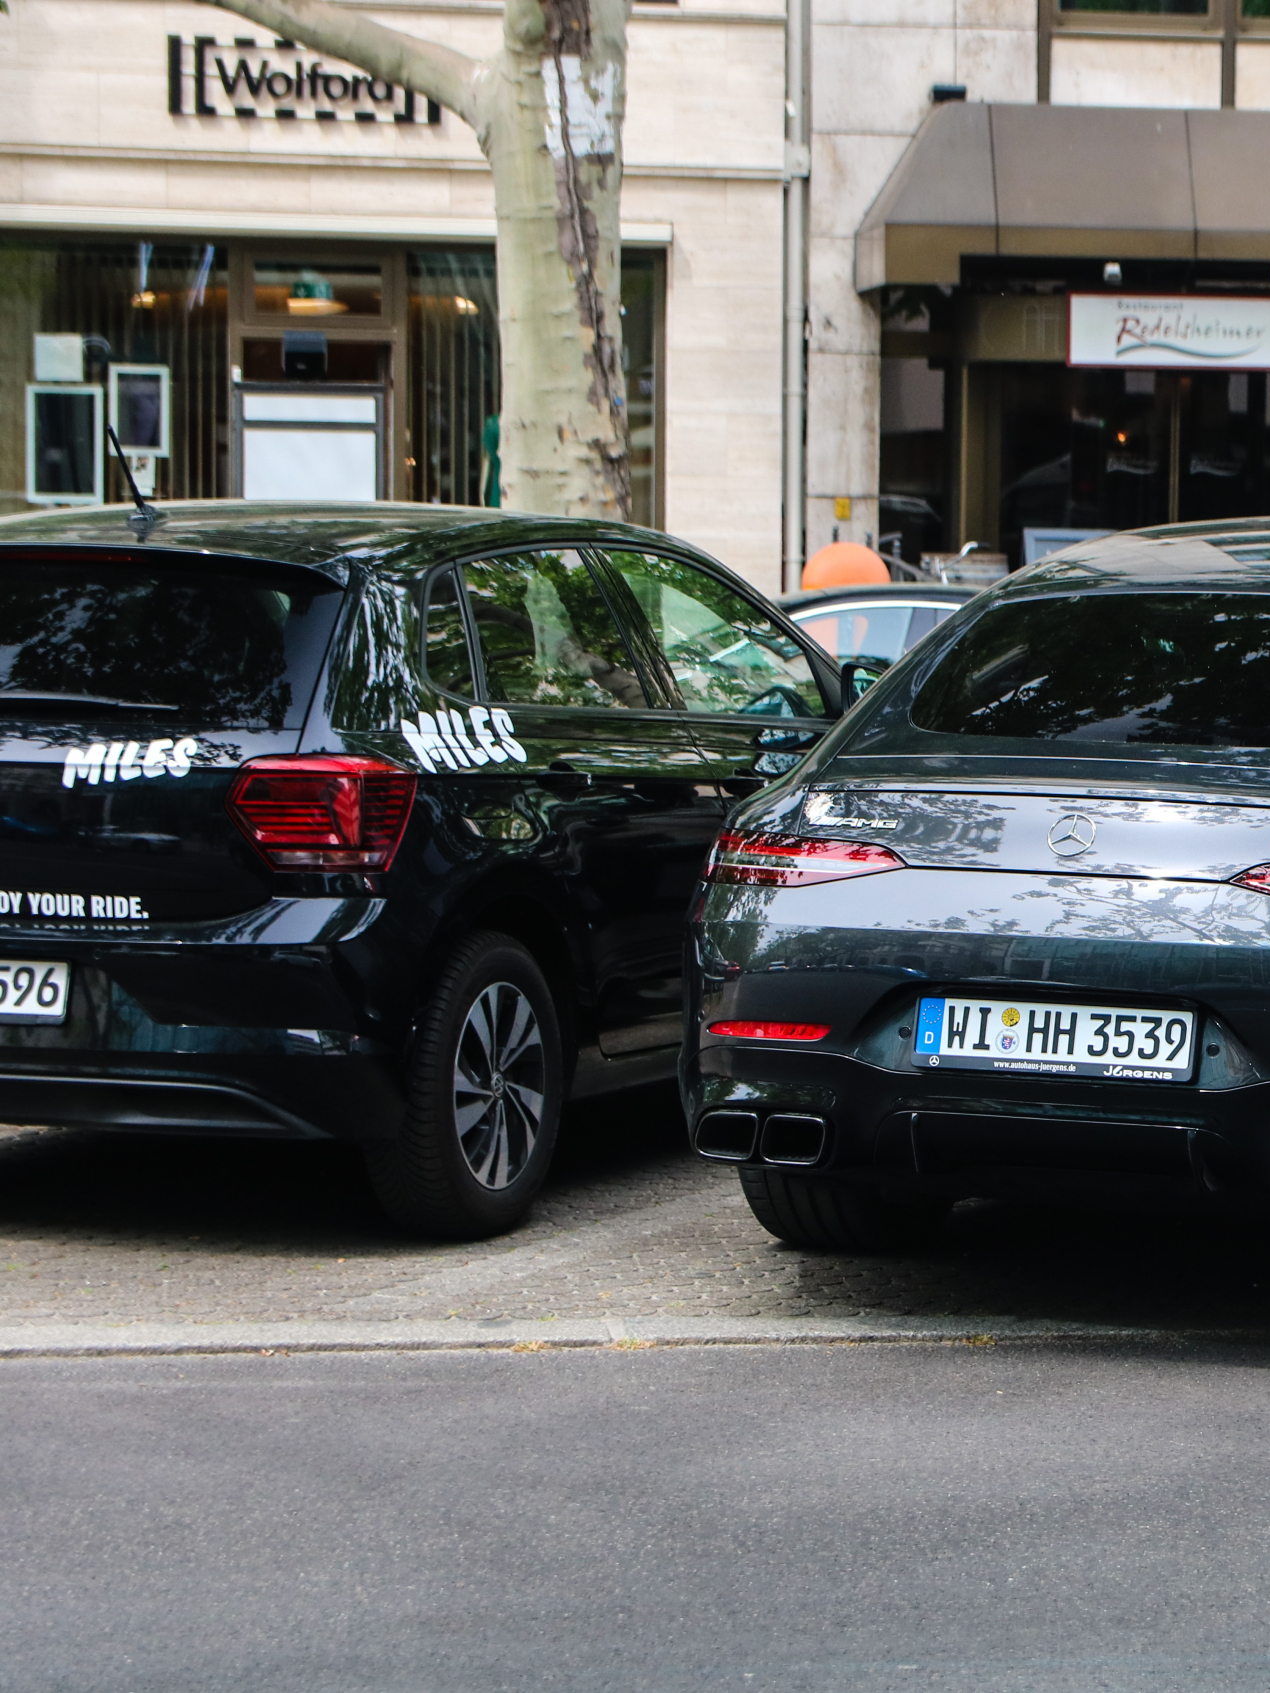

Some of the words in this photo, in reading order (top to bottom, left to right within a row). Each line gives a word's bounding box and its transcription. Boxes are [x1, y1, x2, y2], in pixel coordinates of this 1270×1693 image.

[215, 57, 394, 102] Wolford
[401, 706, 528, 774] MILES
[62, 738, 198, 789] MILES
[836, 817, 899, 829] AMG
[27, 892, 86, 917] YOUR
[90, 895, 150, 919] RIDE.
[924, 1031, 934, 1044] D
[947, 1005, 992, 1050] WI
[1025, 1009, 1078, 1055] HH
[1086, 1013, 1187, 1061] 3539
[993, 1060, 1076, 1073] www.autohaus-juergens.de
